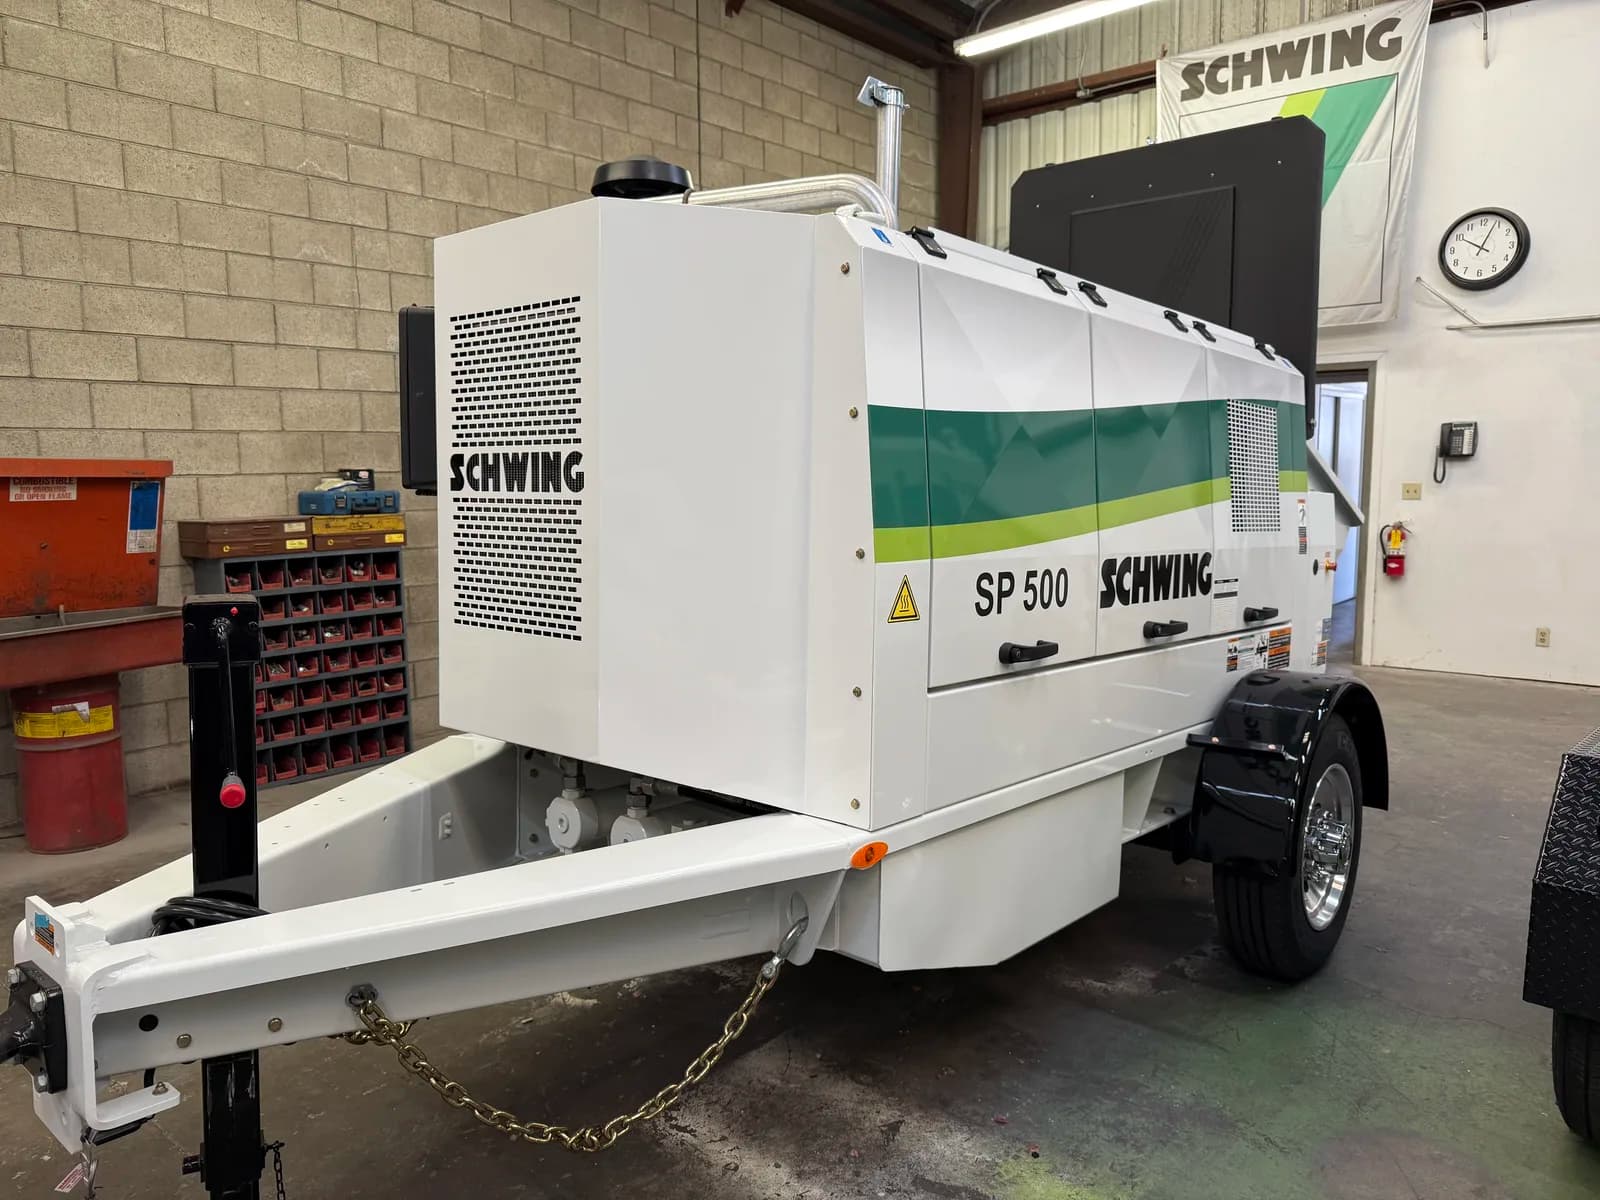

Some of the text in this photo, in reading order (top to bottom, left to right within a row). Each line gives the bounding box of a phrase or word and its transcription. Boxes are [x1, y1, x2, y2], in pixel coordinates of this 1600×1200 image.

[1181, 17, 1403, 103] SCHWING
[1480, 218, 1489, 227] 12
[1467, 223, 1474, 231] 11
[1505, 228, 1511, 236] 2
[1455, 233, 1464, 241] 10
[1509, 241, 1514, 249] 3
[1450, 246, 1455, 255] 9
[1503, 253, 1509, 261] 4
[1453, 258, 1459, 267] 8
[1463, 267, 1468, 275] 7
[1477, 269, 1482, 277] 6
[1491, 265, 1497, 273] 5
[450, 451, 585, 493] SCHWING
[1100, 552, 1213, 609] SCHWING
[974, 567, 1069, 617] SP 500
